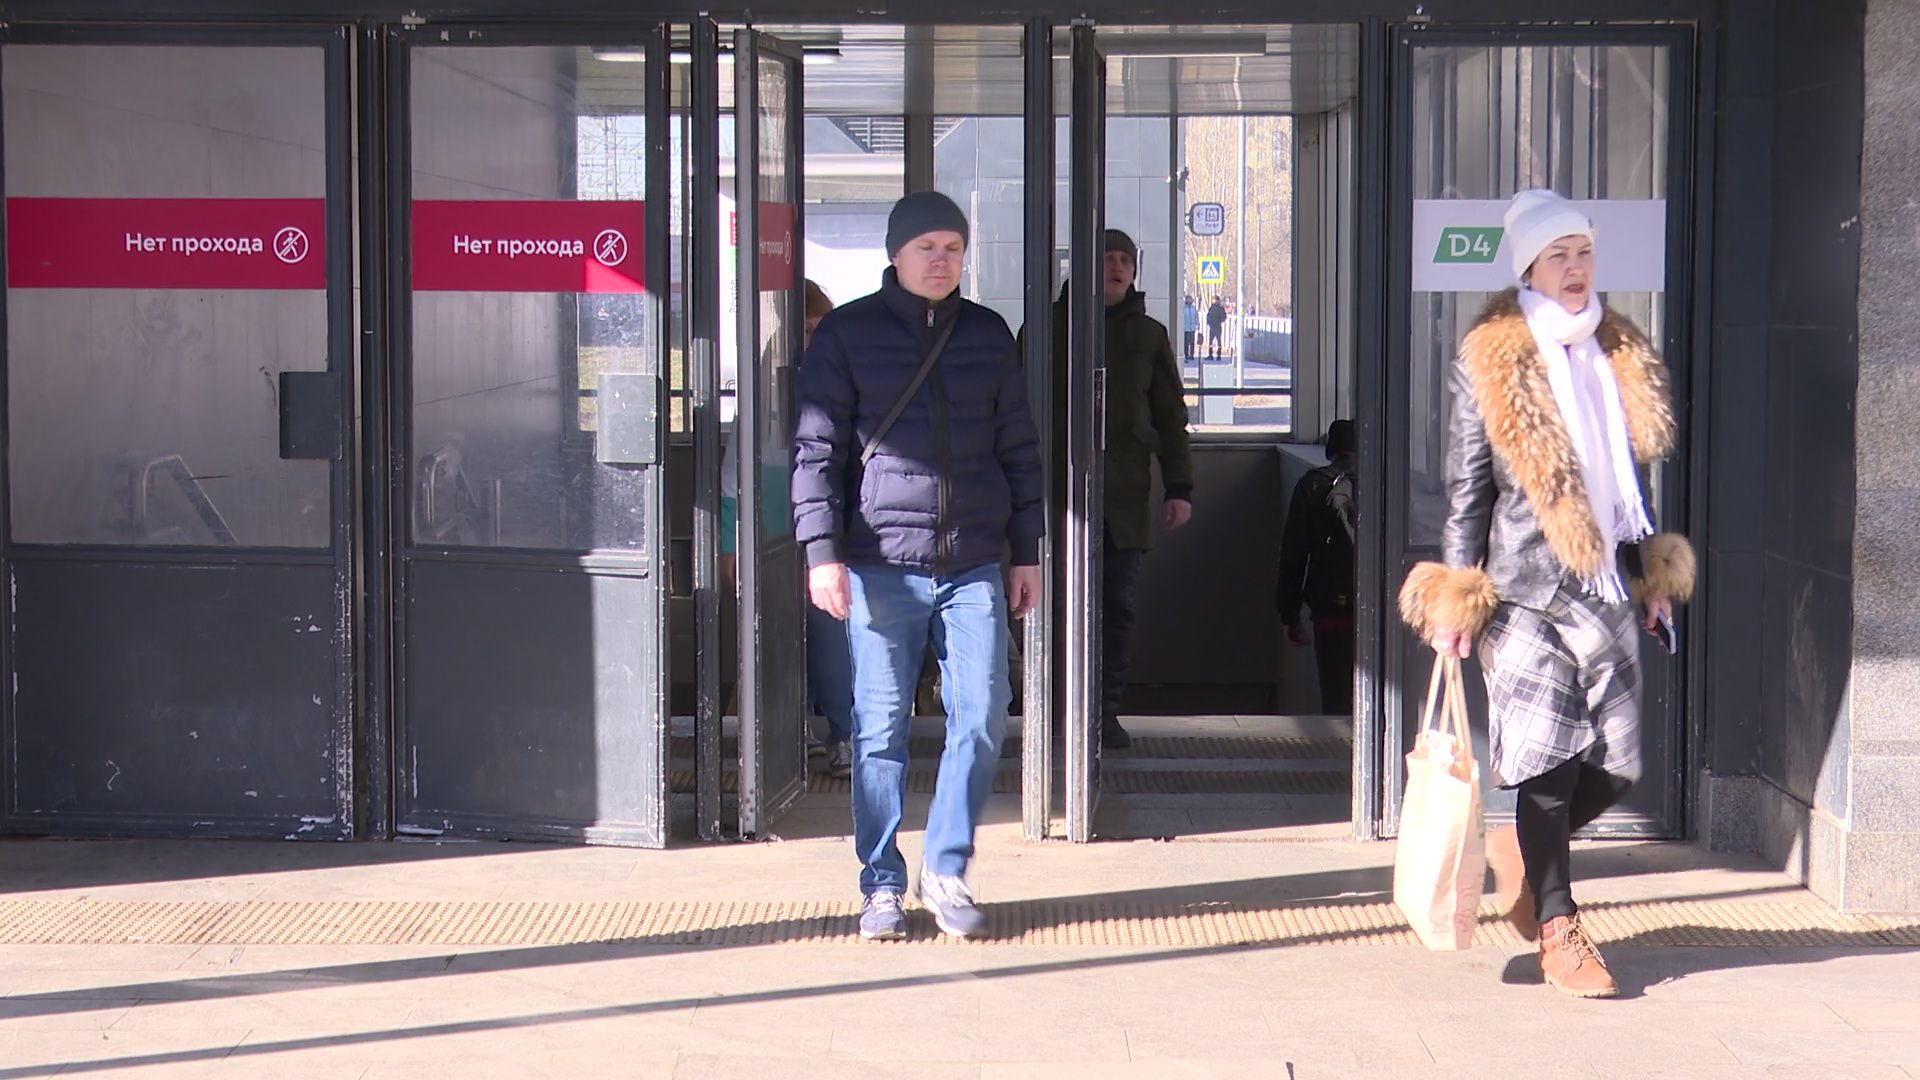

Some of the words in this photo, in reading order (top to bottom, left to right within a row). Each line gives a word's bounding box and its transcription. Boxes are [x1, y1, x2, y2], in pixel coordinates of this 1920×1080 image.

[125, 232, 167, 252] Нет
[172, 237, 264, 256] прохода
[453, 235, 493, 254] Нет
[497, 239, 585, 259] прохода
[1447, 233, 1492, 257] D4
